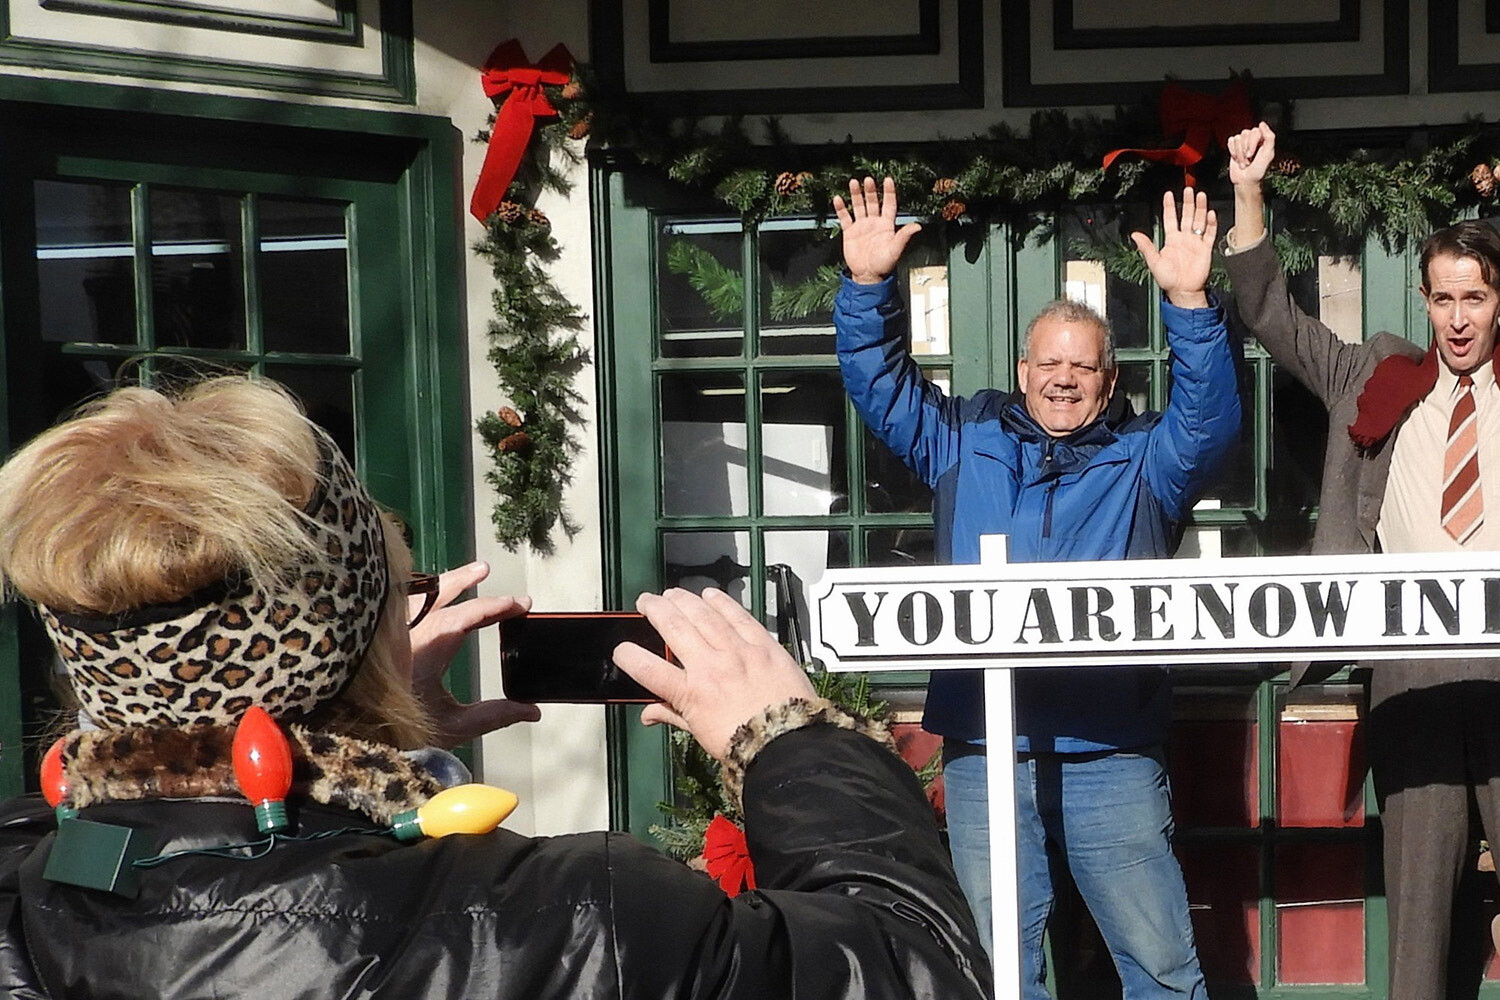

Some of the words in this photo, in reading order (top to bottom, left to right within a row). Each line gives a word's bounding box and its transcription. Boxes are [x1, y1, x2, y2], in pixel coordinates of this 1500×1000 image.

[842, 588, 998, 648] YOU
[1013, 584, 1175, 645] ARE
[1189, 580, 1359, 641] NOW
[1380, 578, 1465, 637] IN
